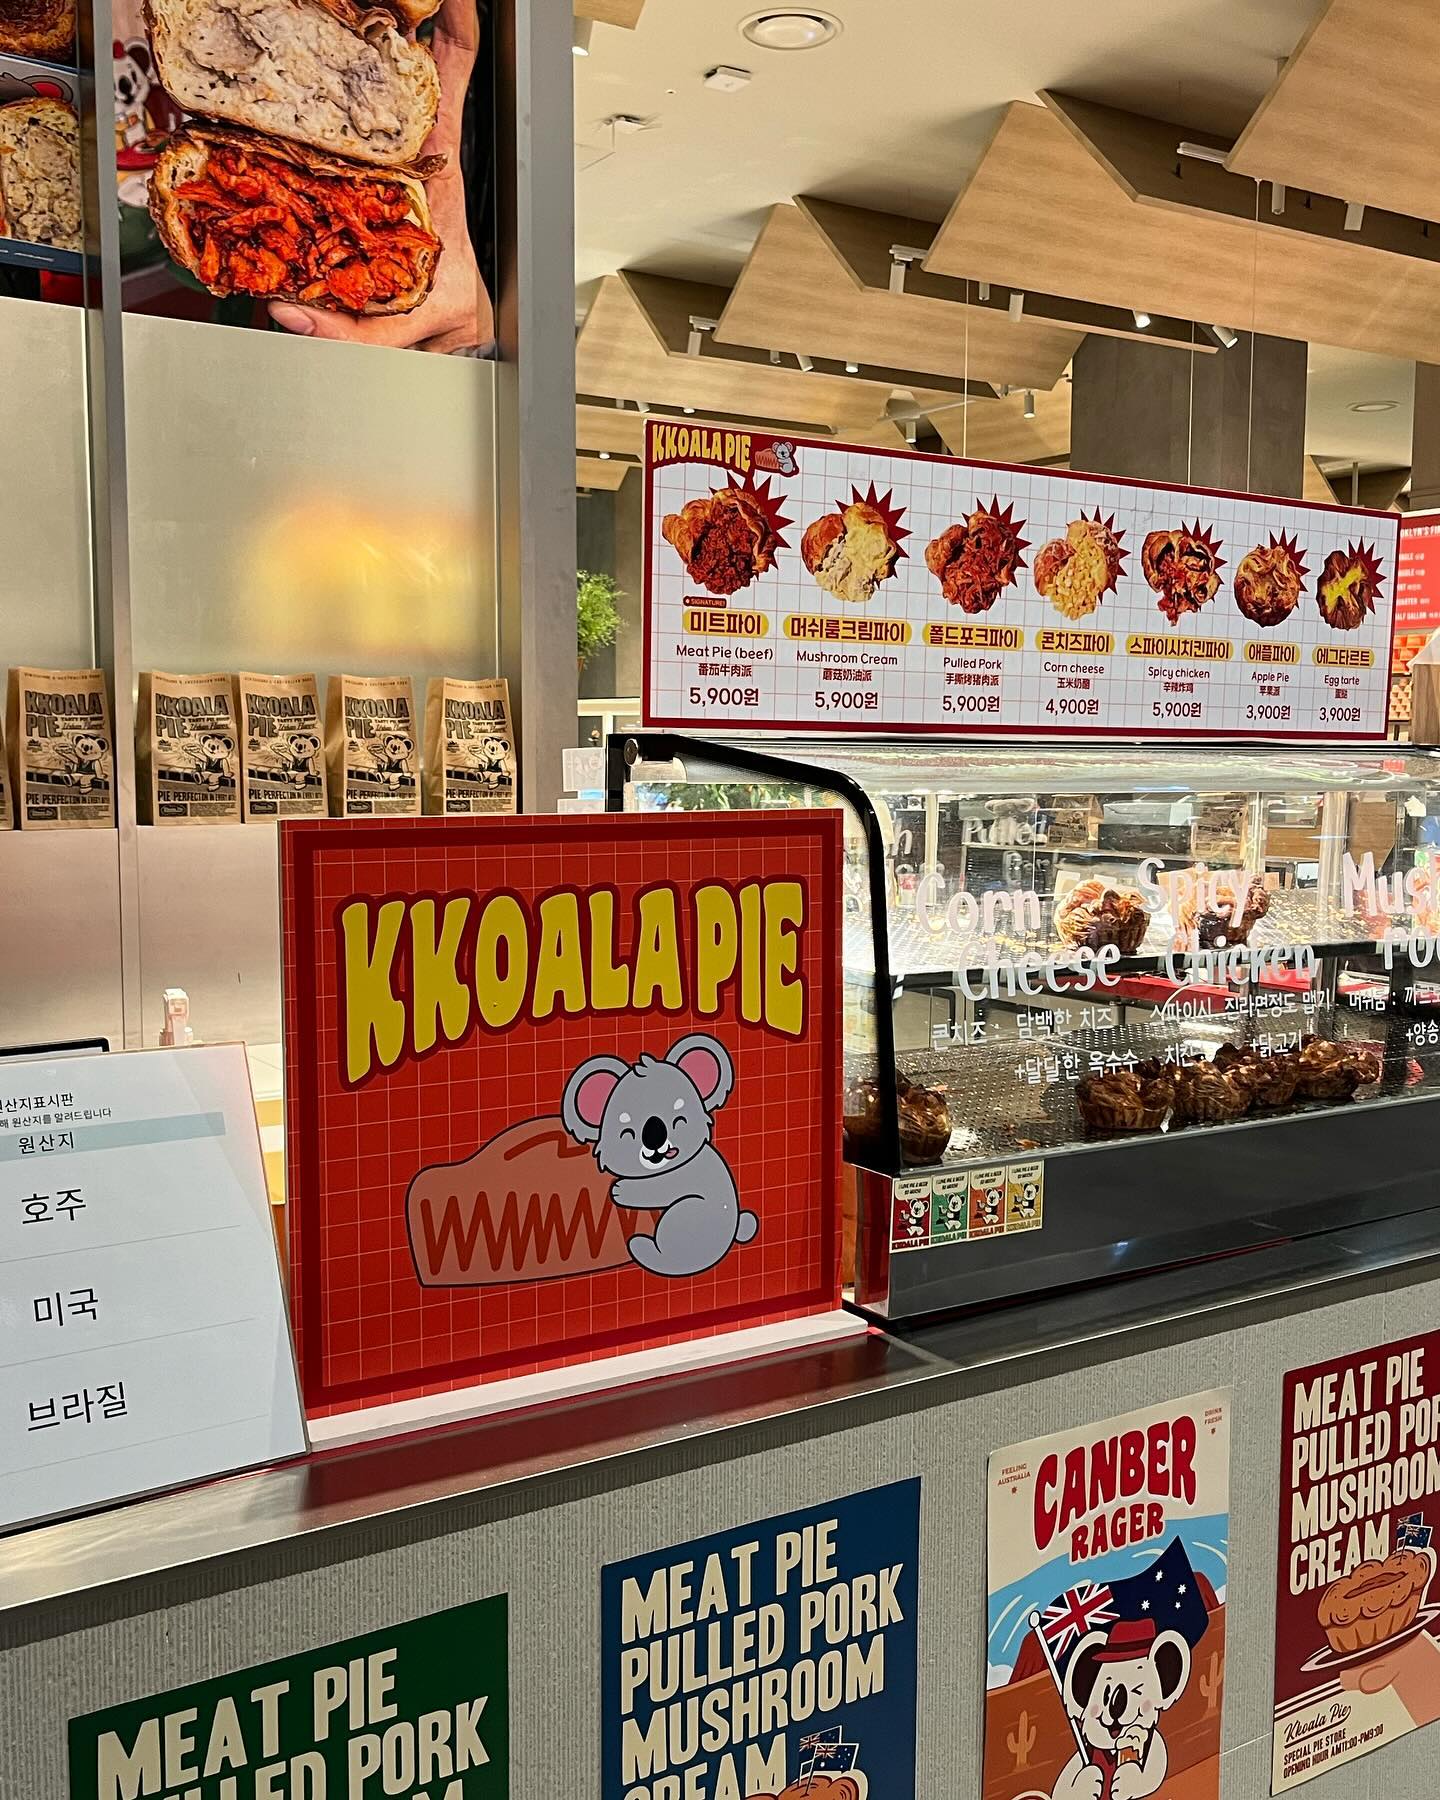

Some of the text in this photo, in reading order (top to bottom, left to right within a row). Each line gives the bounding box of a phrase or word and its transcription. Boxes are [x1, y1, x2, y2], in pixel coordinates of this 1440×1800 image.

[652, 424, 751, 472] KKOALA PIE
[690, 611, 761, 635] 미트파이
[790, 617, 905, 642] 머쉬룸크림파이
[929, 625, 1018, 648] 폴드포크파이
[1041, 631, 1110, 652] 콘치즈파이
[1130, 637, 1229, 659] 스파이시치킨파이
[676, 645, 773, 661] Meat Pie (beef)
[796, 650, 898, 666] Mushroom Cream
[943, 657, 1002, 670] Pulled Pork
[1248, 644, 1295, 662] 애플파이
[1316, 648, 1370, 666] 에그타르트
[698, 663, 752, 677] 番茄牛肉派
[1044, 662, 1105, 674] Corn cheese
[1148, 666, 1210, 679] Spicy chicken
[1251, 671, 1289, 683] Apple Pie
[1324, 675, 1339, 686] Egg
[25, 690, 102, 715] KKOALA
[155, 693, 229, 717] KKOALA
[246, 693, 316, 717] KKOALA
[345, 696, 409, 718] KKOALA
[689, 687, 760, 707] 5,900원
[814, 691, 879, 710] 5,900원
[942, 695, 1000, 714] 5,900원
[1045, 699, 1099, 716] 4,900원
[445, 698, 505, 720] KKOALA
[1152, 702, 1202, 718] 5,900원
[1246, 704, 1291, 720] 3,900원
[1319, 707, 1360, 721] 3,900원
[26, 714, 63, 738] PIE
[156, 715, 190, 738] PIE
[248, 715, 279, 738] PIE
[345, 718, 376, 738] PIE
[445, 720, 474, 739] PIE
[26, 793, 39, 804] PIE
[158, 791, 170, 801] PIE
[249, 789, 262, 799] PIE
[346, 789, 357, 799] PIE
[446, 788, 456, 798] PIE
[916, 872, 1041, 934] Corn
[1137, 857, 1250, 928] Spicy
[957, 939, 1122, 1001] Cheese
[1164, 936, 1317, 987] Chicken
[342, 882, 803, 1083] KKOALA PIE
[1225, 992, 1298, 1020] 진라면정도
[1302, 987, 1331, 1014] 맵기
[932, 1007, 1114, 1051] 콘치즈 담백한 치즈
[1089, 1049, 1140, 1079] 옥수수
[0, 1092, 73, 1114] 산지표시판
[12, 1114, 51, 1128] 원산지를
[54, 1107, 112, 1124] 알려드립니다
[19, 1131, 74, 1154] 원산지
[20, 1188, 87, 1226] 호주
[34, 1288, 99, 1327] 미국
[1293, 1348, 1425, 1433] MEAT PIE
[27, 1381, 128, 1433] 브라질
[1204, 1407, 1222, 1417] DRINK
[1204, 1415, 1222, 1425] FRESH
[1291, 1410, 1391, 1488] PULLED
[997, 1471, 1031, 1487] AUSTRALIA
[1001, 1463, 1027, 1476] FEELING
[1034, 1415, 1197, 1551] CANBER
[1071, 1502, 1164, 1563] RAGER
[1290, 1514, 1390, 1596] CREAM
[622, 1518, 838, 1644] MEAT PIE
[621, 1563, 904, 1715] PULLED PORK
[622, 1633, 884, 1786] MUSHROOM
[98, 1648, 397, 1800] MEAT PIE
[1284, 1703, 1351, 1742] Kkoala Pie
[348, 1695, 490, 1800] PORK
[1284, 1728, 1346, 1765] SPECIAL PIE STORE
[1283, 1757, 1310, 1779] OPENING
[1312, 1749, 1329, 1766] HOUR
